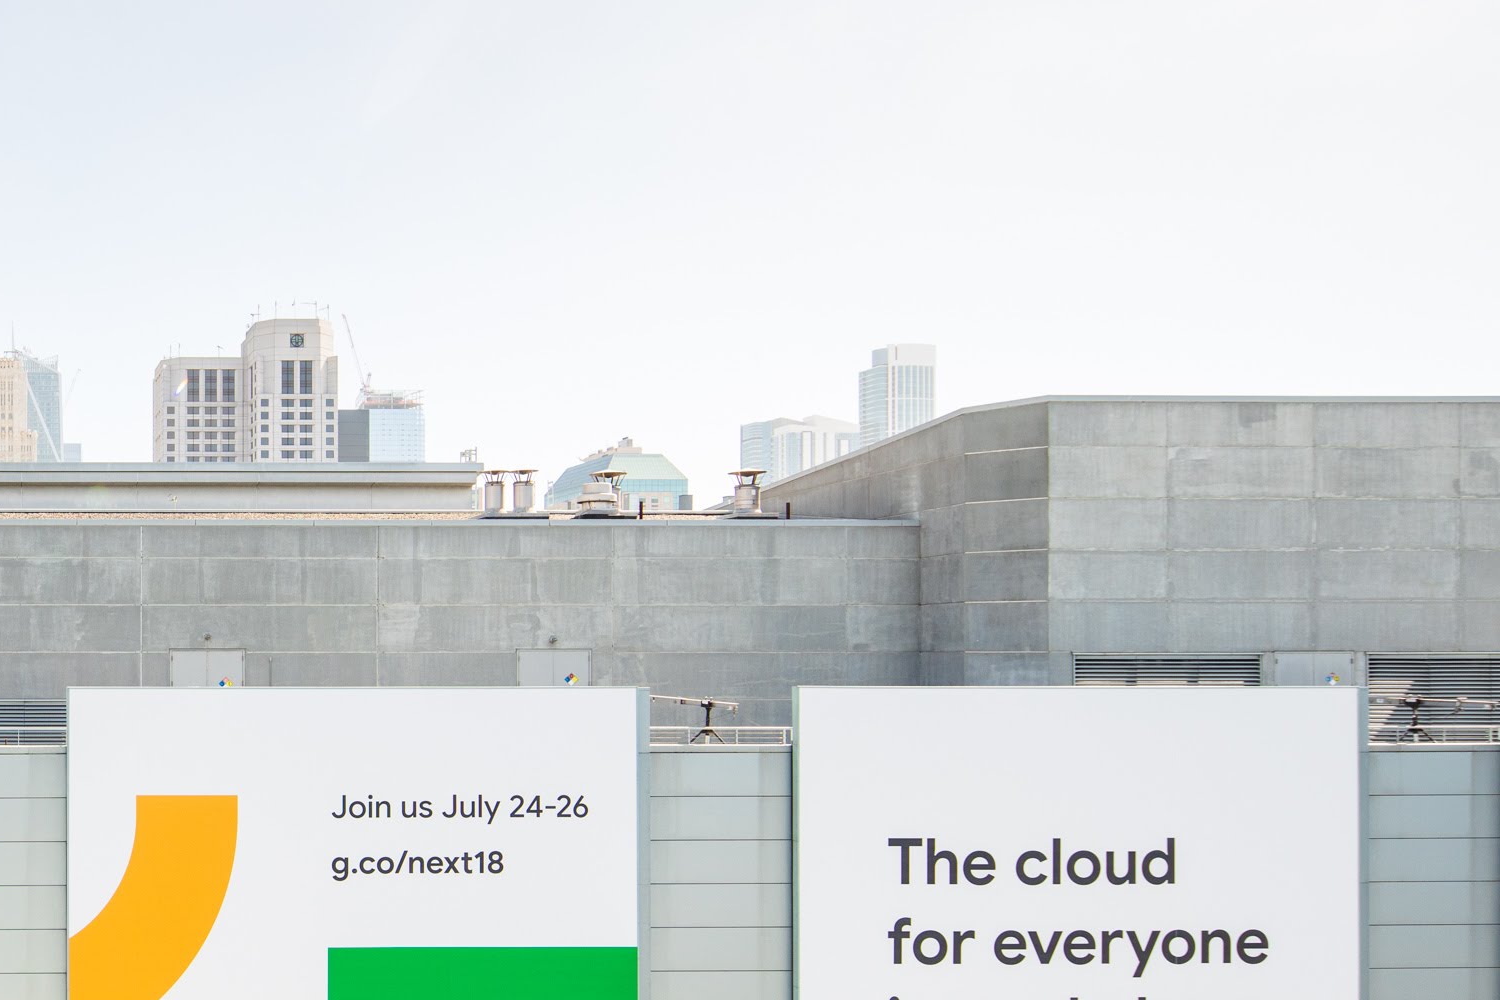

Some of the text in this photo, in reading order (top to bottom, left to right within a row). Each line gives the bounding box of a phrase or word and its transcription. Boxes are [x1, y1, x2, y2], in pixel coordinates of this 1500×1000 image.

[331, 794, 589, 825] Join us July 24-26
[331, 850, 505, 882] g.co/next18
[887, 837, 1176, 886] The cloud
[887, 916, 1270, 978] for everyone
